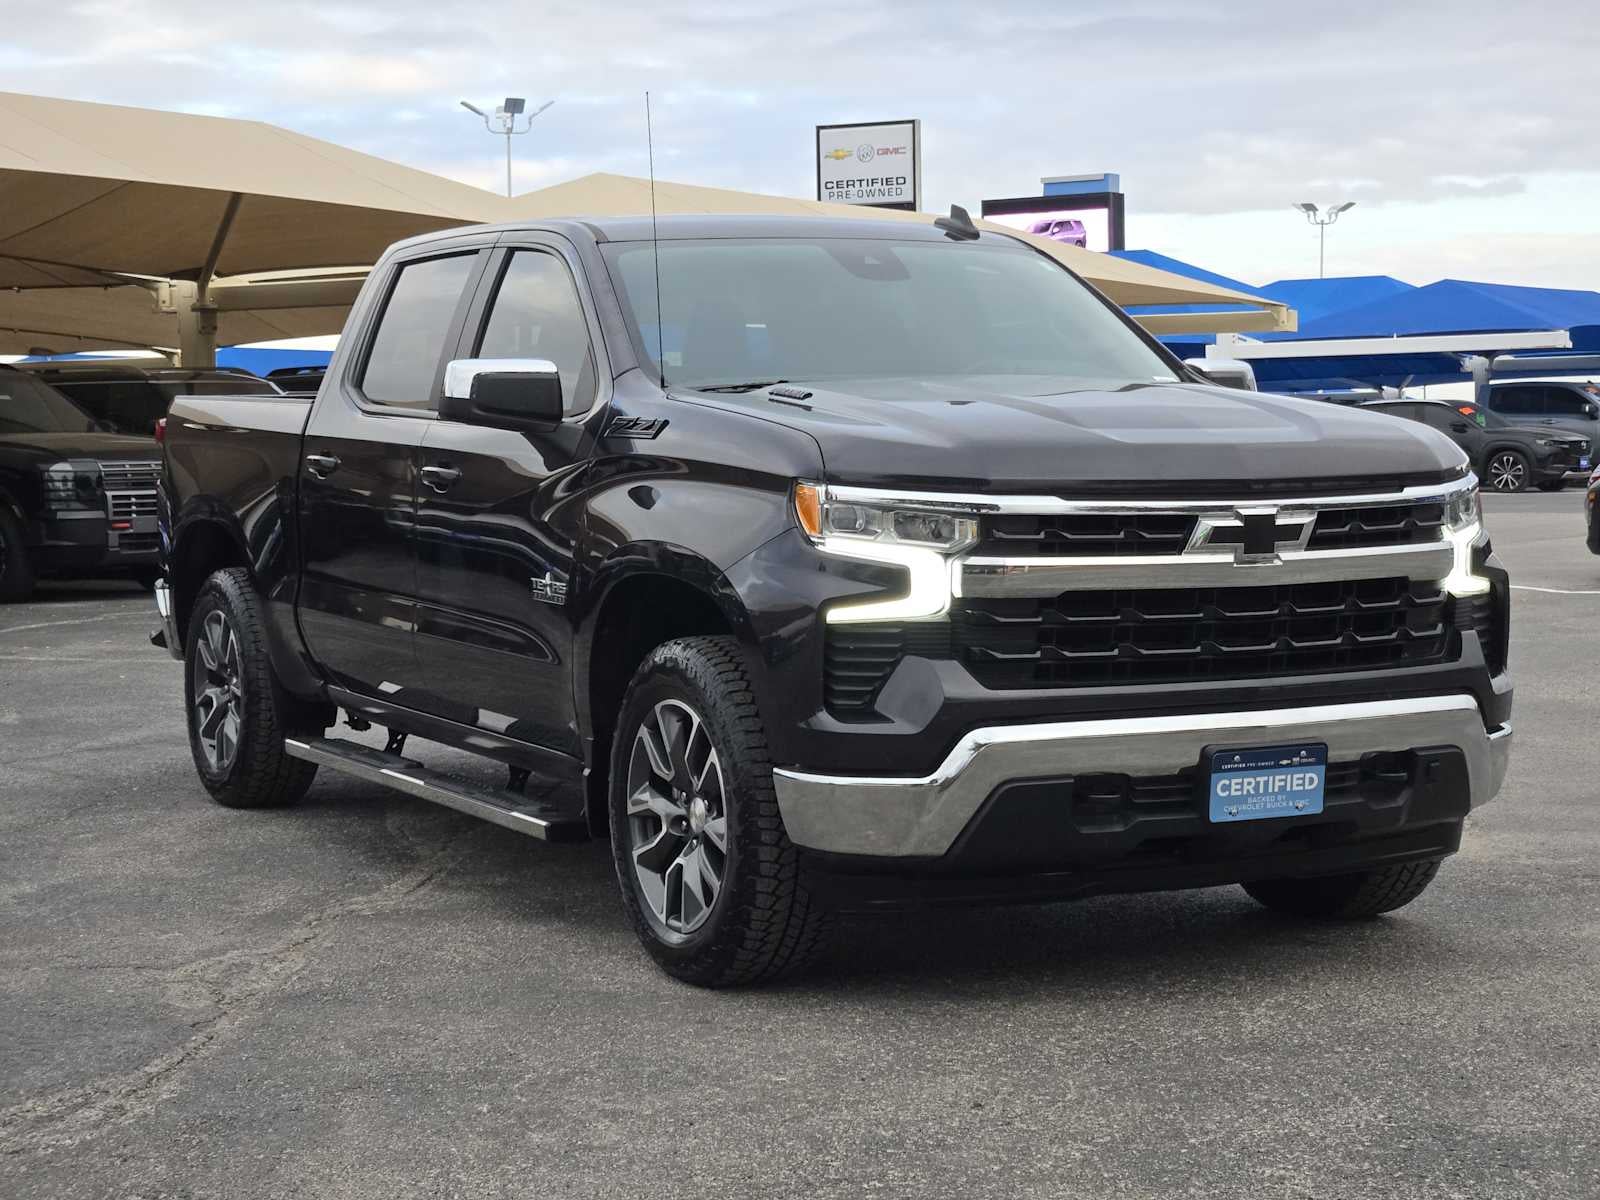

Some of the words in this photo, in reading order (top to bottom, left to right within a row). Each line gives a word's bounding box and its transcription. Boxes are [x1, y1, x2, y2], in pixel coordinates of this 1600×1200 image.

[877, 146, 907, 156] GMC
[824, 176, 907, 190] CERTIFIED
[828, 187, 903, 201] PRE-OWNED
[604, 416, 670, 440] Z71
[530, 574, 567, 594] TEXAS
[1216, 772, 1319, 797] CERTIFIED
